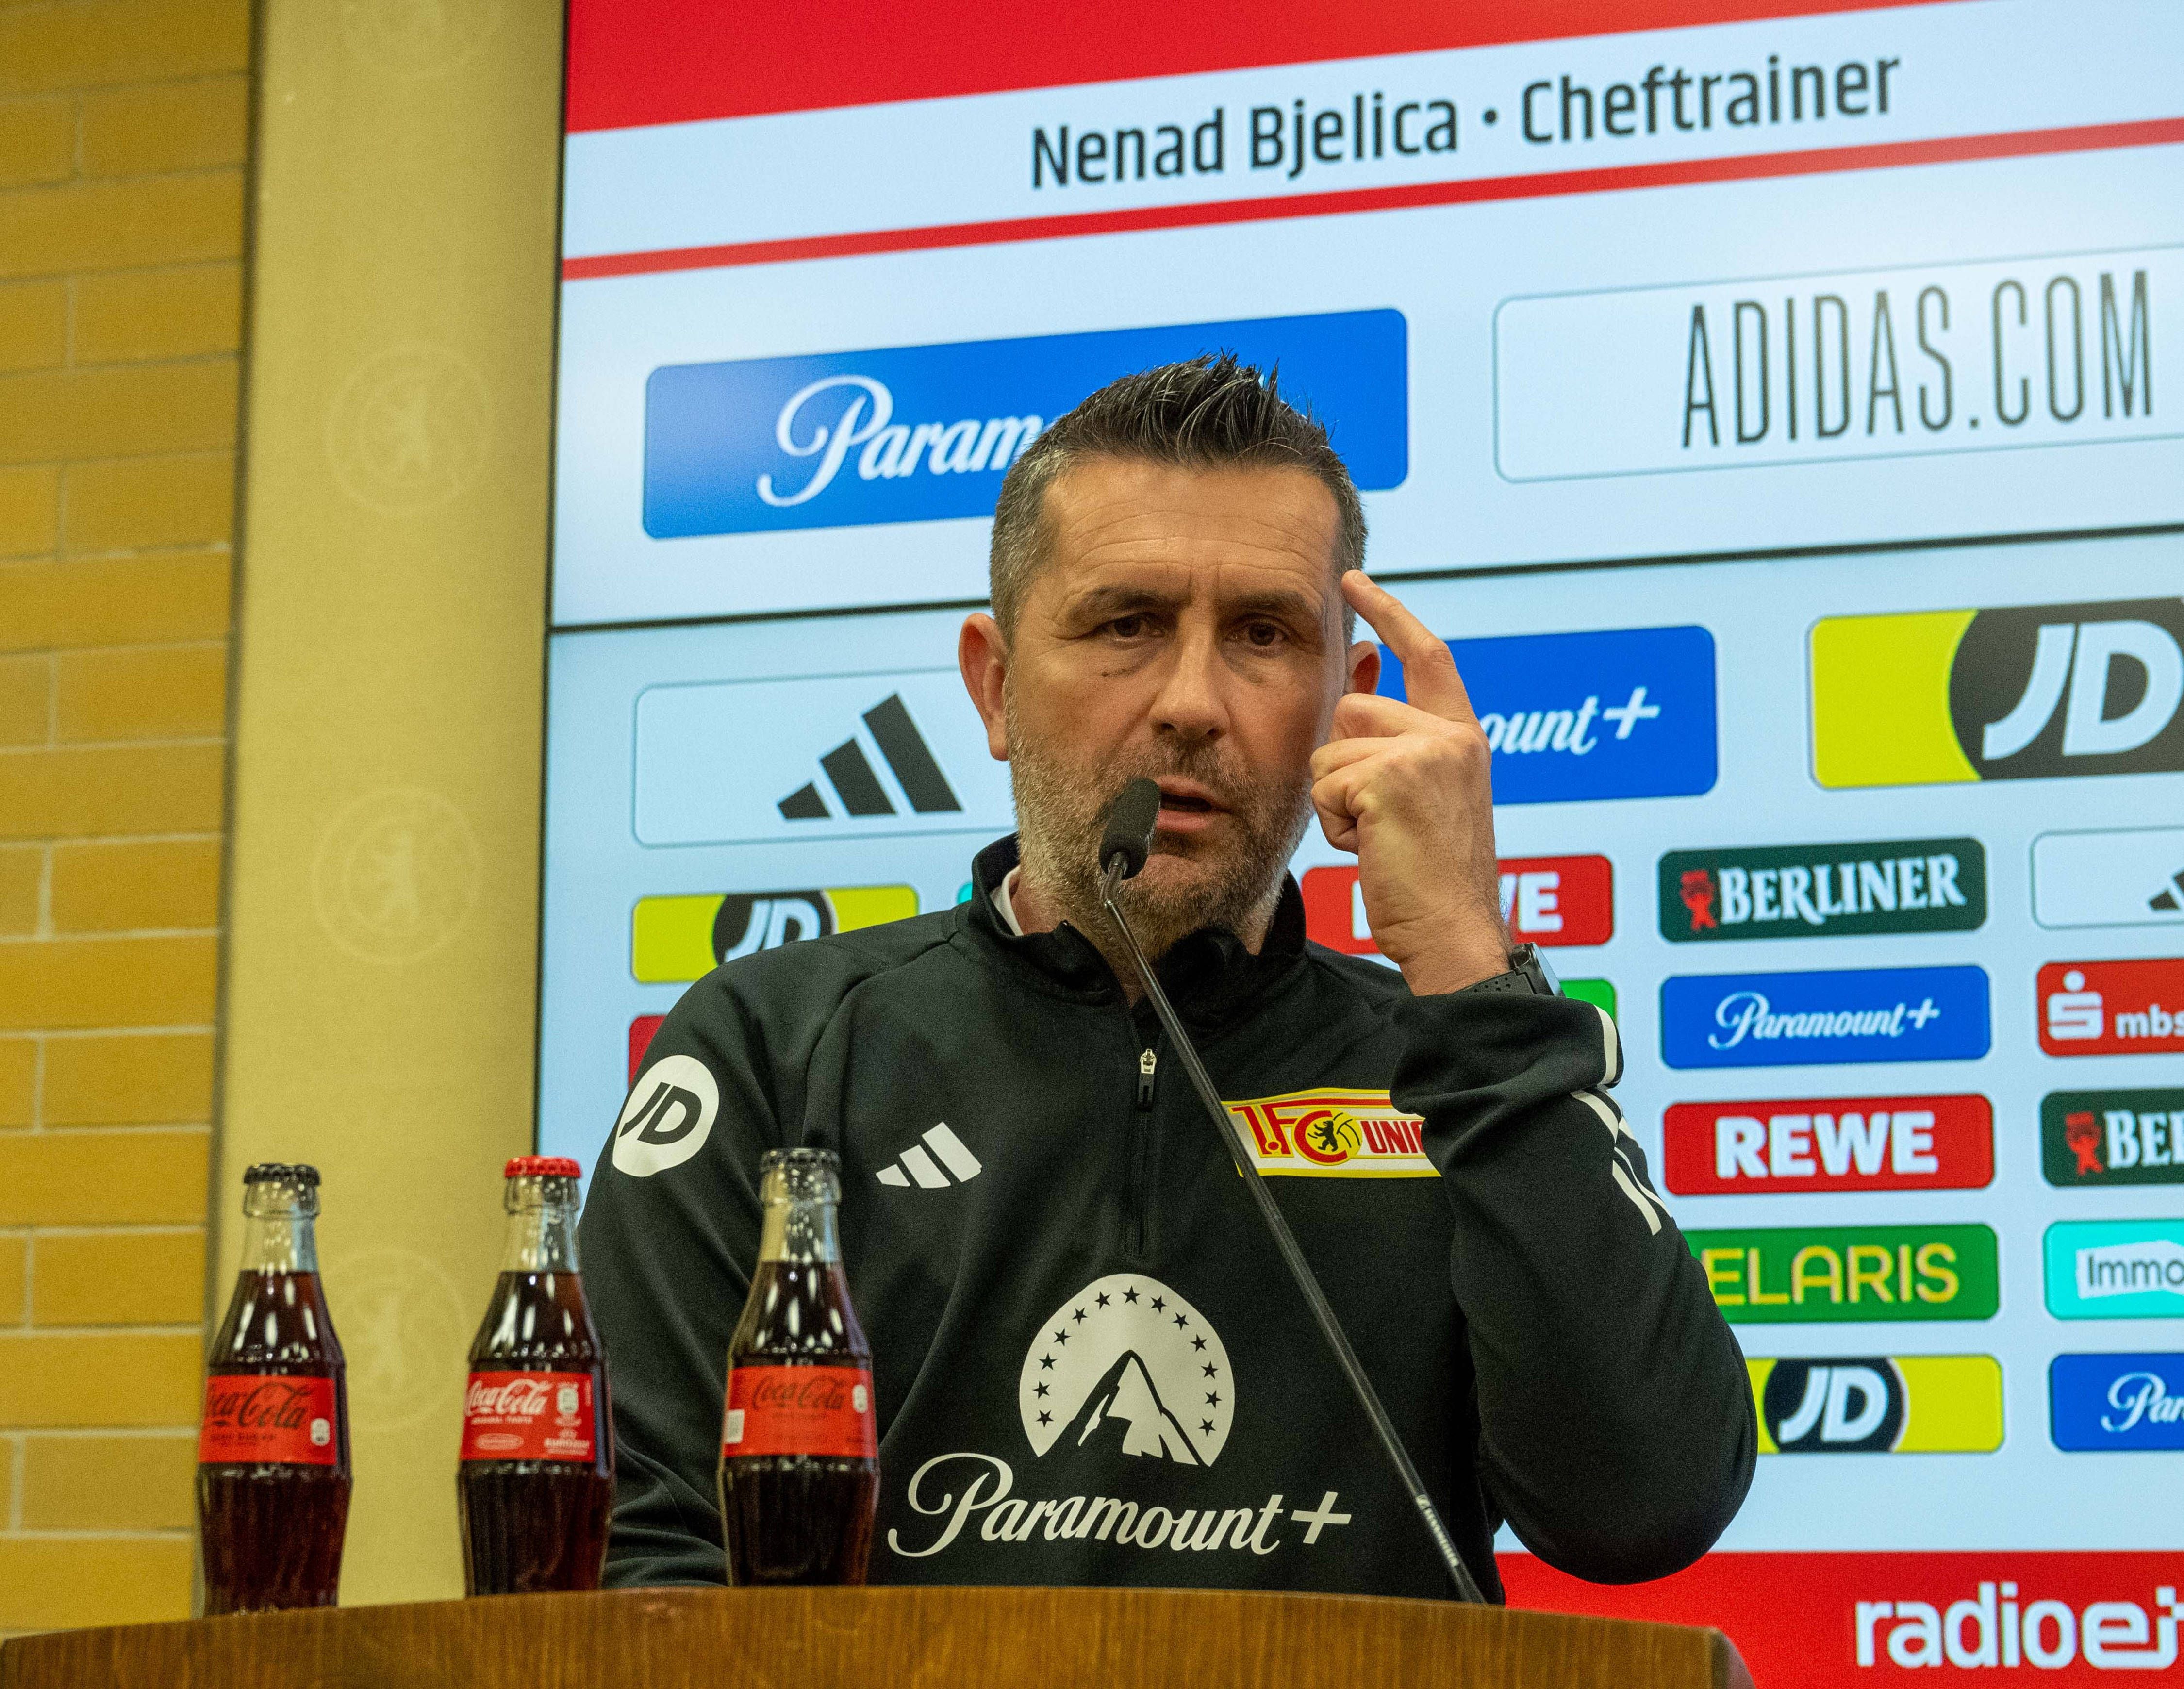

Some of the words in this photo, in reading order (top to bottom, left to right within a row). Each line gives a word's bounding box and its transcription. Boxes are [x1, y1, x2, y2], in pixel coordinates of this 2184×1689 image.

[1033, 106, 1224, 188] Nenad
[1250, 91, 1458, 181] Bjelica
[1521, 54, 1901, 143] Cheftrainer
[1683, 270, 2151, 449] ADIDAS.COM
[756, 374, 1065, 507] Param
[1982, 620, 2184, 761] JD
[1717, 853, 1967, 925] BERLINER
[724, 898, 821, 963] JD
[1707, 990, 1940, 1050] Paramount+
[619, 1081, 702, 1145] JD
[1715, 1110, 1939, 1178] REWE
[1701, 1242, 1959, 1306] ELARIS
[2088, 1255, 2184, 1286] Immo
[1778, 1366, 1888, 1443] JD
[887, 1452, 1352, 1557] Paramount+
[1855, 1581, 2184, 1670] radioei
